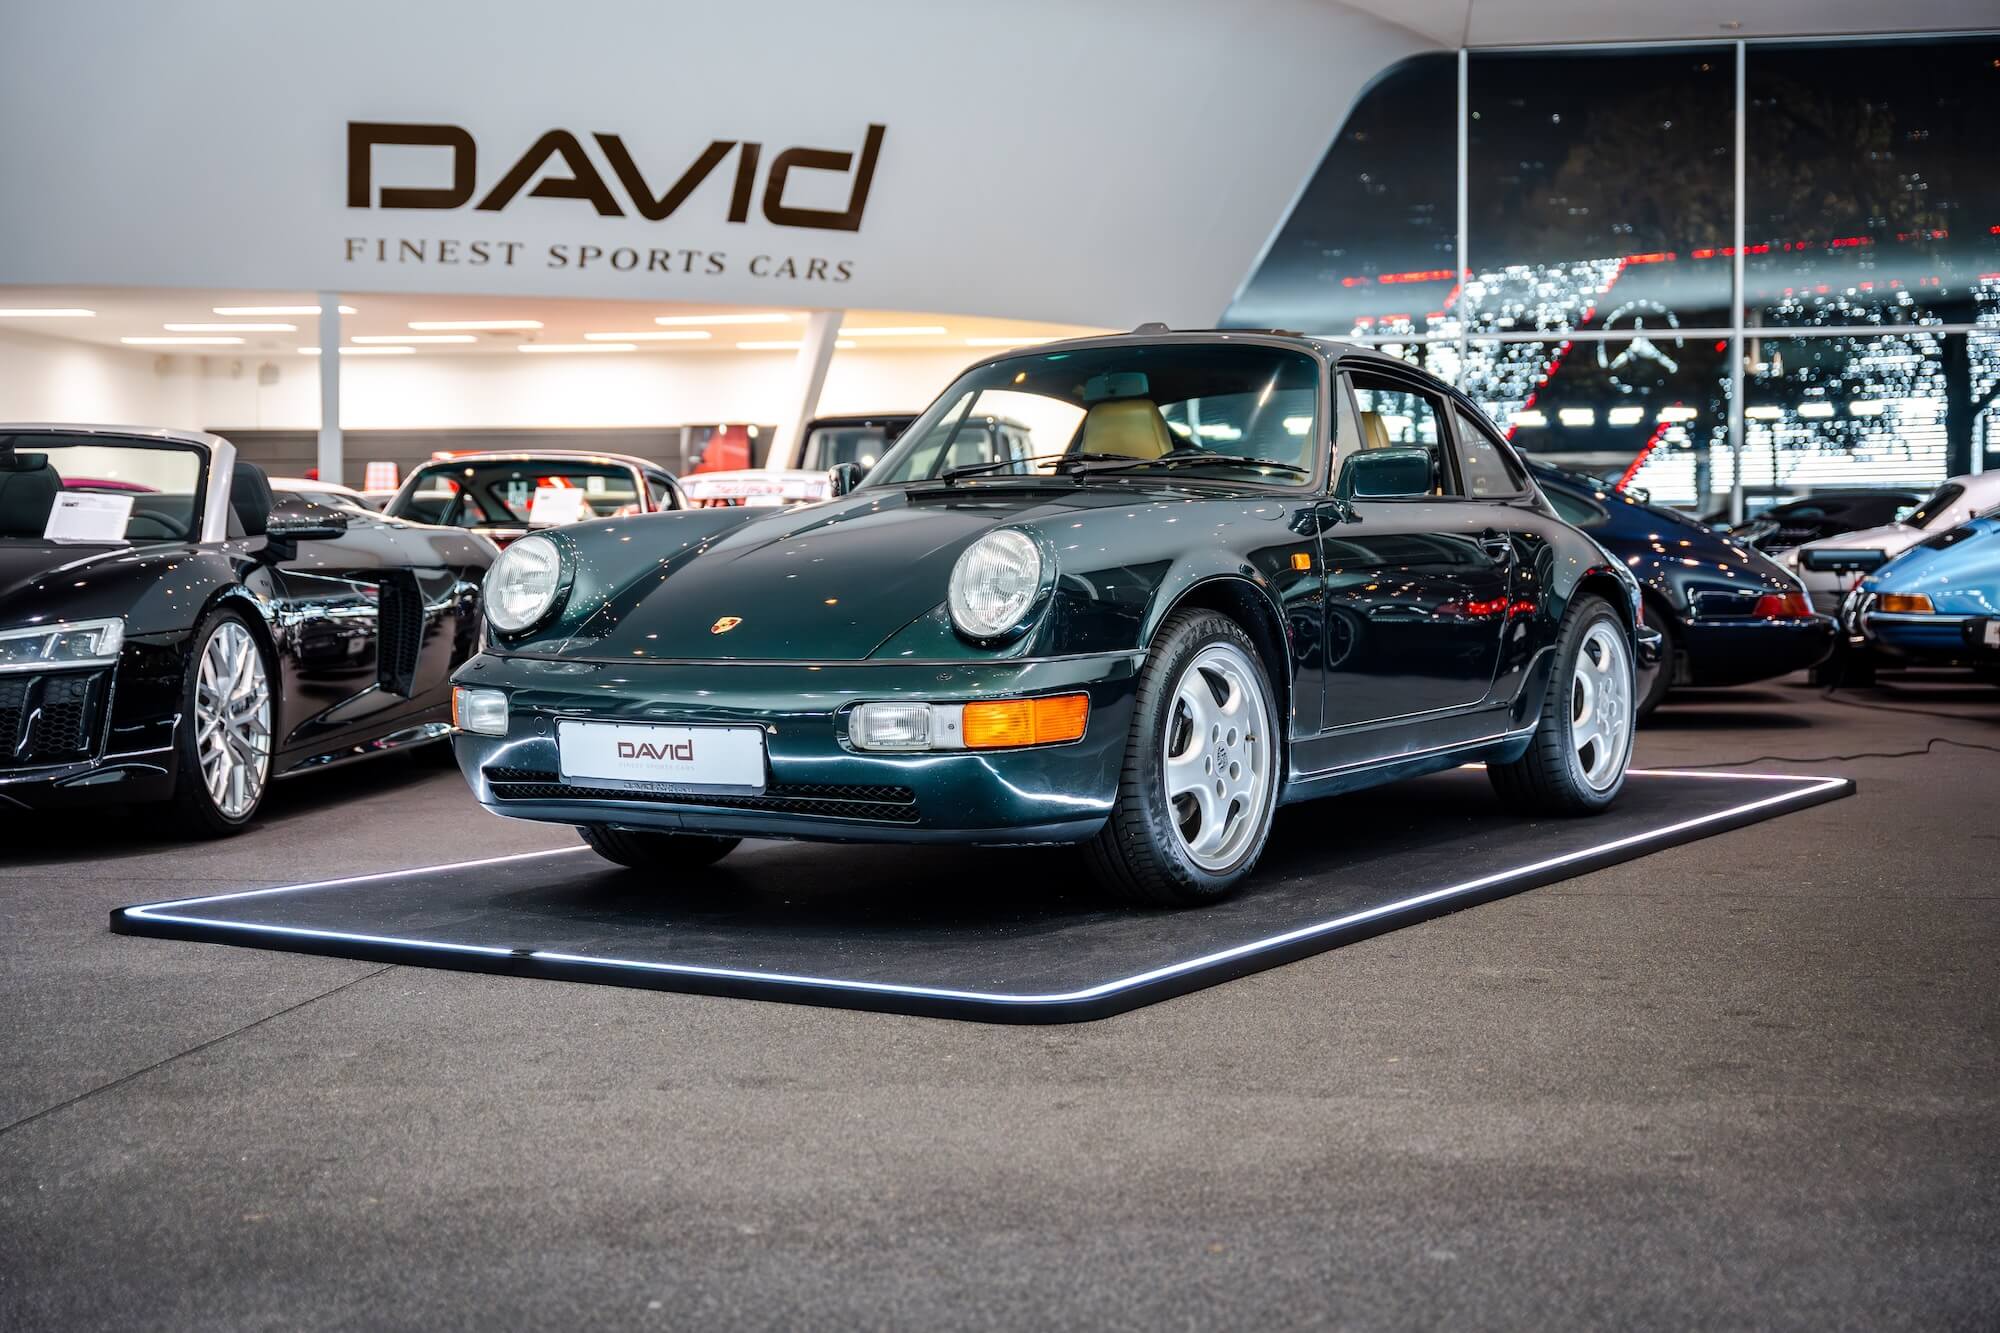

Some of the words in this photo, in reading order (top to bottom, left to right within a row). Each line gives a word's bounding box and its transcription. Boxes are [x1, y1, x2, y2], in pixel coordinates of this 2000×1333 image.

[345, 237, 523, 266] FINEST
[547, 245, 726, 275] SPORTS
[748, 255, 853, 283] CARS
